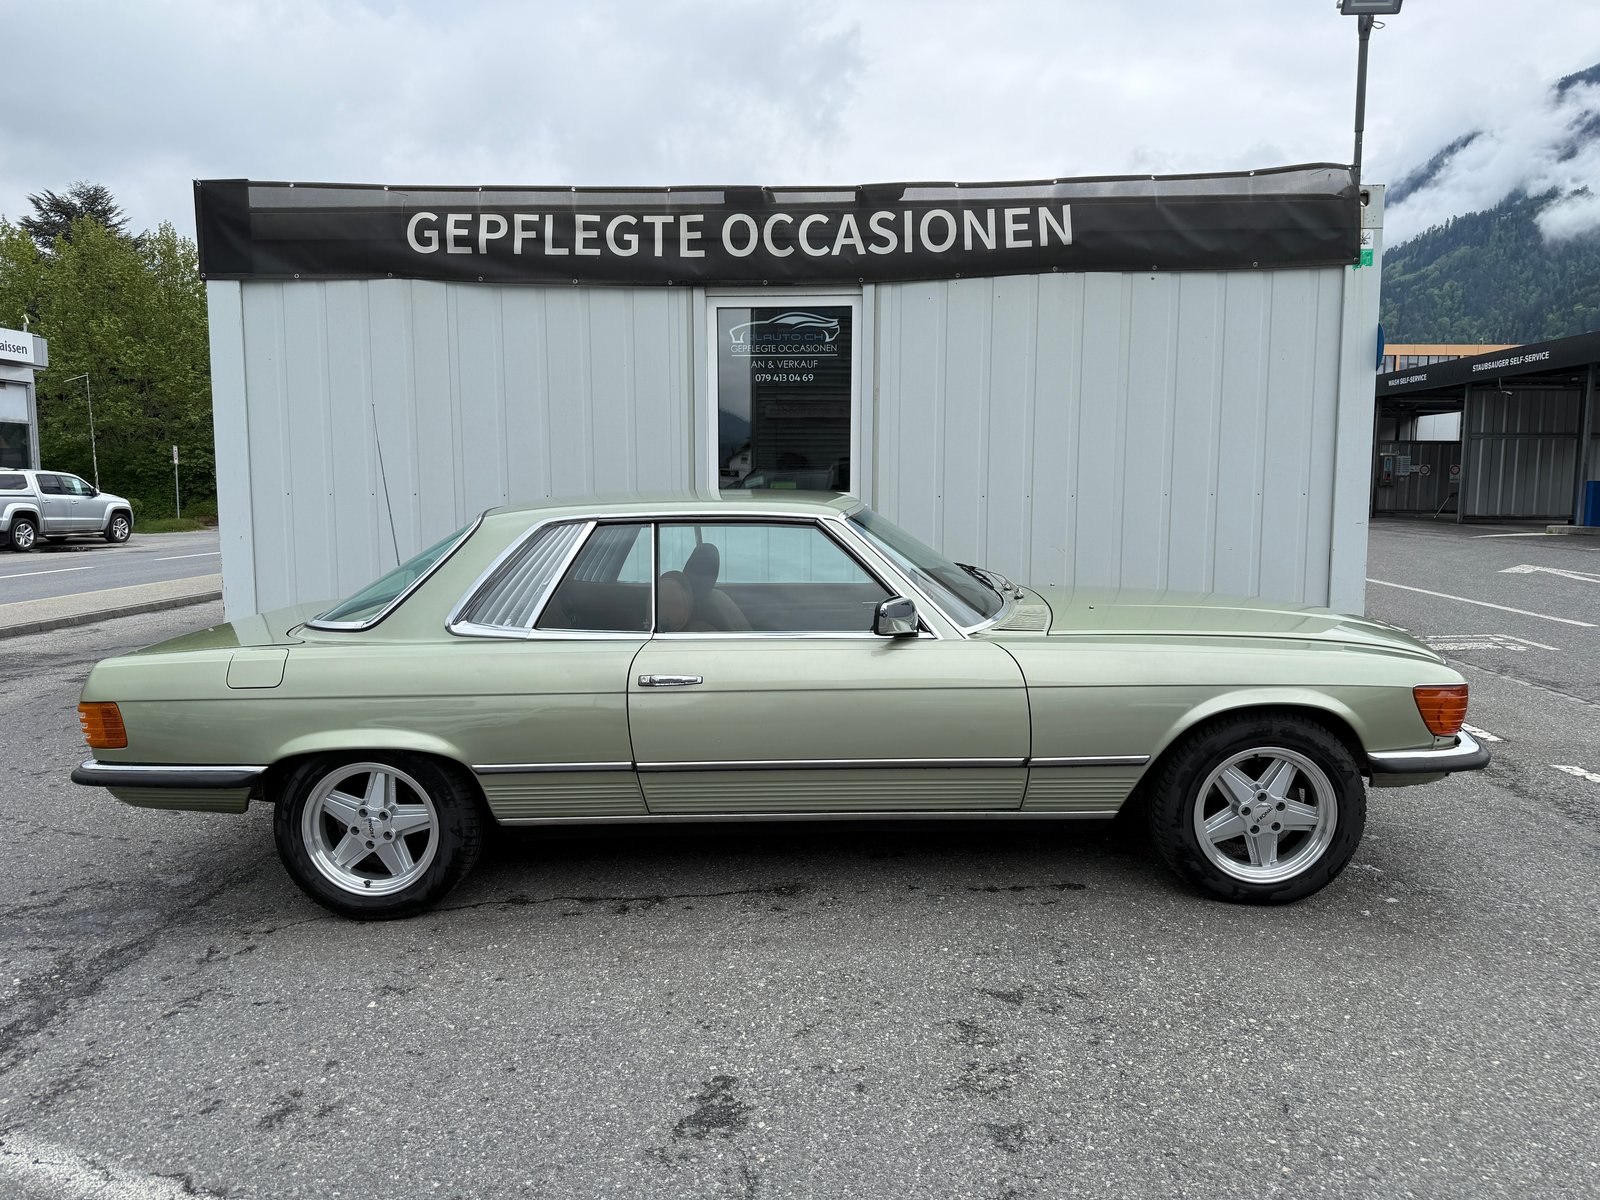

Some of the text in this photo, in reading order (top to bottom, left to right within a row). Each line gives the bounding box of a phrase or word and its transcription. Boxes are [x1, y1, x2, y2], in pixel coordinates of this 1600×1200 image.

[406, 203, 1074, 258] GEPFLEGTE OCCASIONEN
[730, 344, 838, 353] GEPFLEGTE OCCASIONEN
[750, 359, 818, 369] AN & VERKAUF
[1472, 350, 1550, 372] STAUBSAUGER SELF-SERVICE
[755, 373, 814, 382] 079 413 04 69
[1399, 373, 1427, 385] SELF-SERVICE
